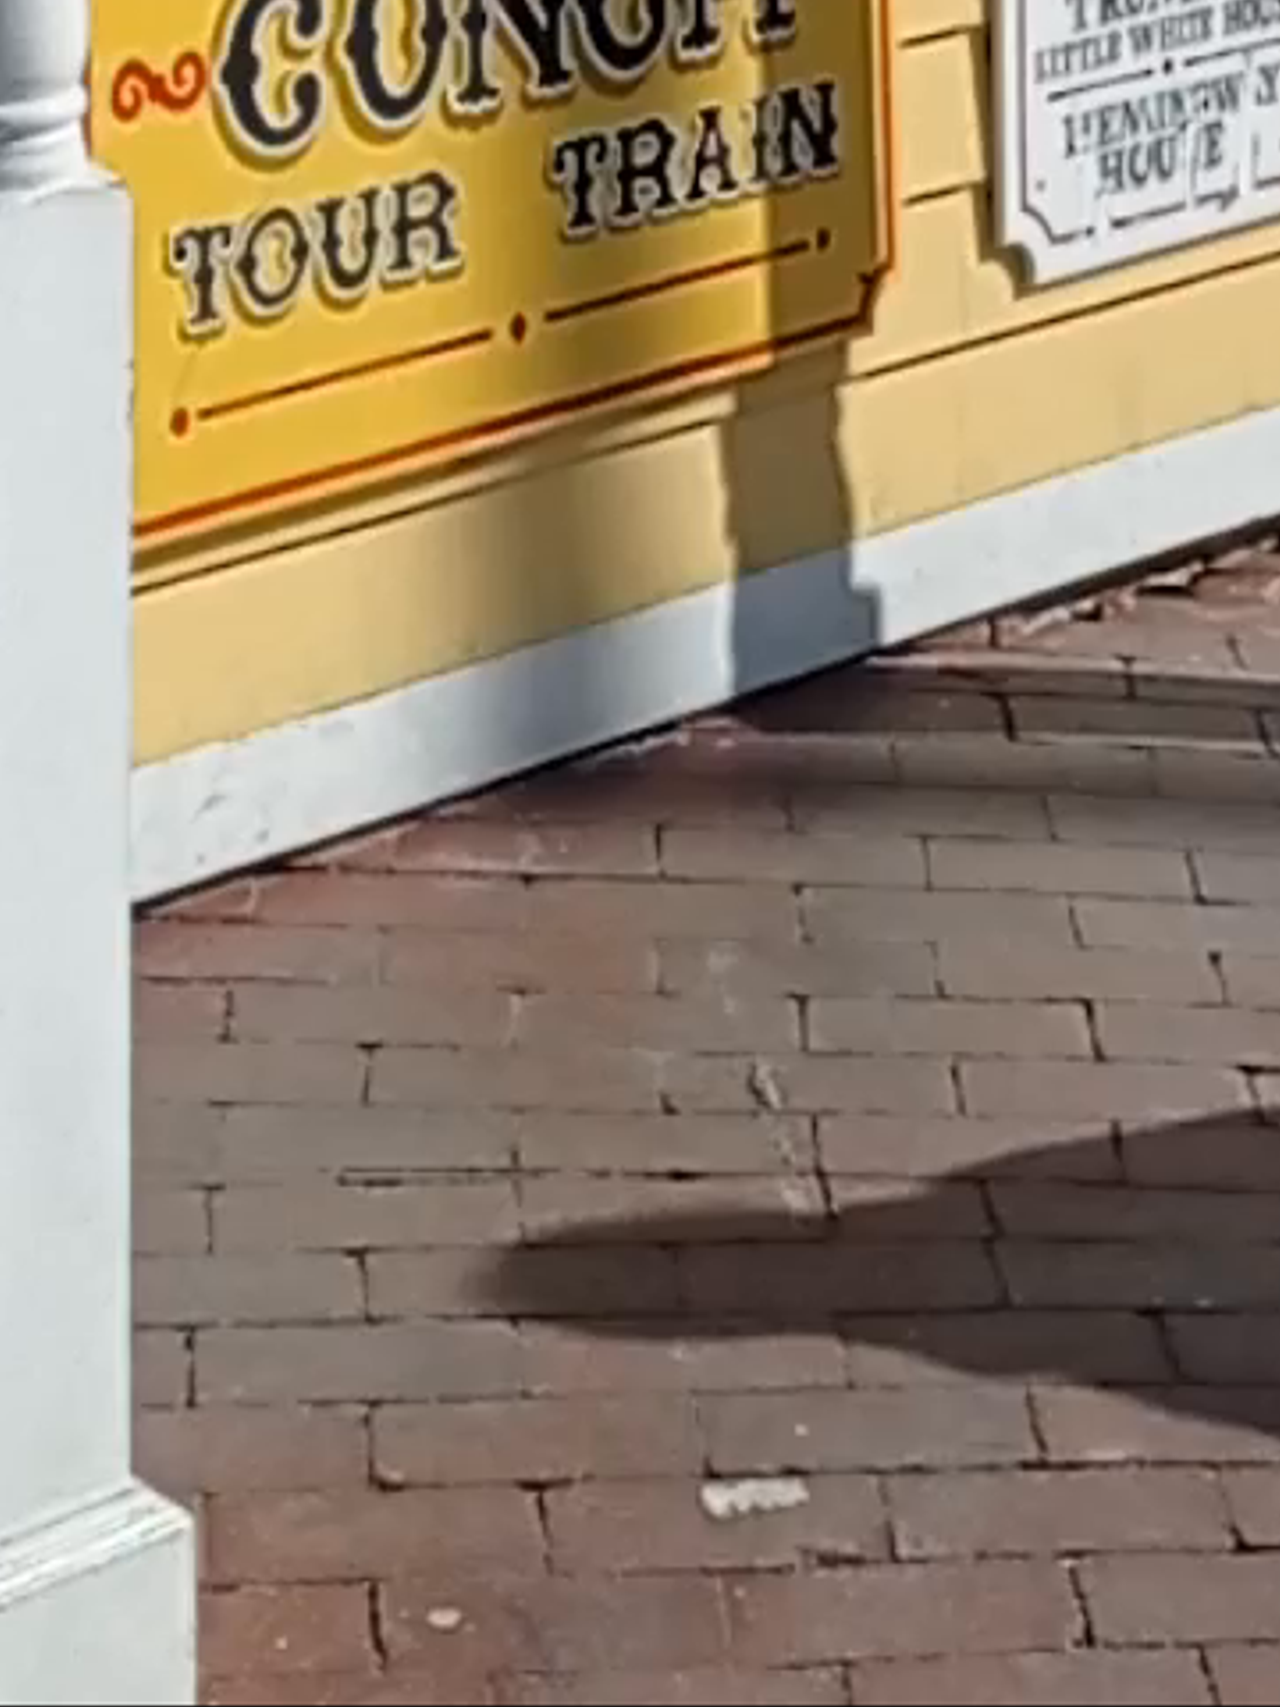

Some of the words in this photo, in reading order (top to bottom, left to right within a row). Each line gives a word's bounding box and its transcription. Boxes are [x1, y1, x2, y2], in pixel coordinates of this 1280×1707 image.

[1035, 29, 1122, 84] LITTLE
[1128, 5, 1214, 54] WHITE
[1097, 121, 1223, 193] HOUE
[171, 169, 459, 329] TOUR
[554, 81, 840, 233] TRAIN
